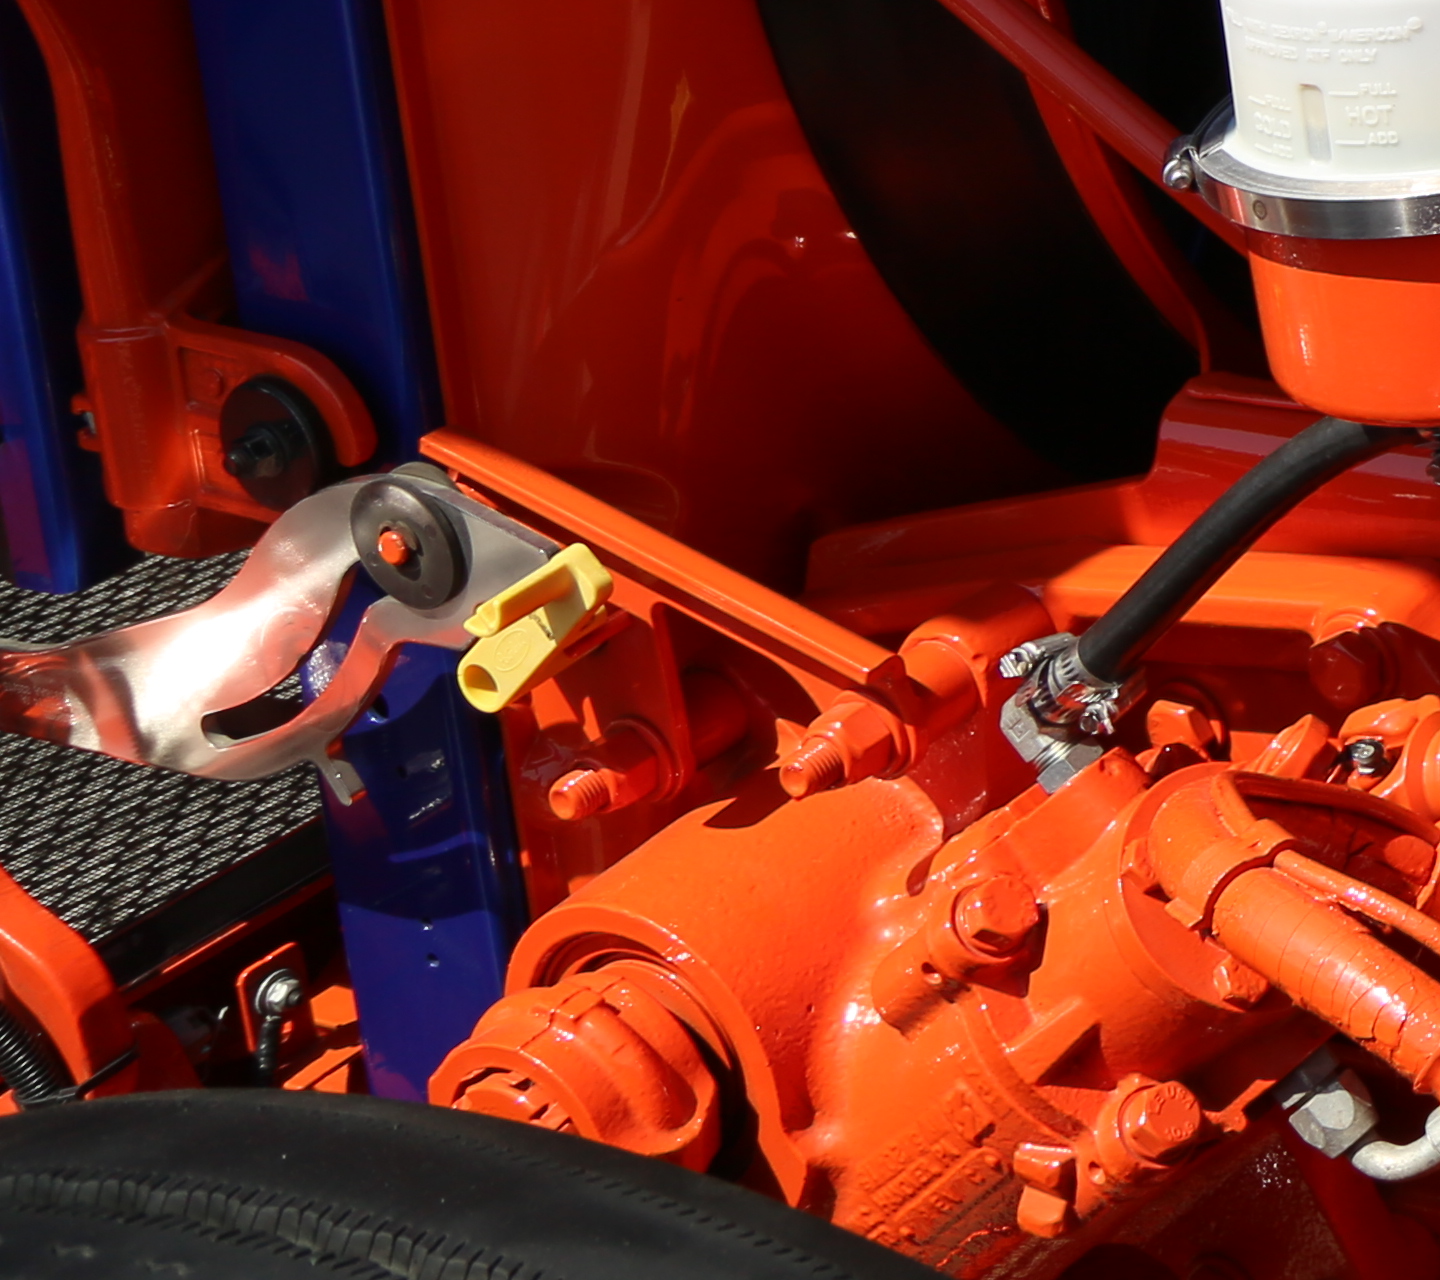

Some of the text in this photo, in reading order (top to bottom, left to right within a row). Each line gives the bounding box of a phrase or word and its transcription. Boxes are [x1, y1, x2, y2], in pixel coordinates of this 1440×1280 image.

[1305, 47, 1331, 61] ATF
[1337, 46, 1377, 64] ONLY
[1359, 82, 1397, 96] FULL
[1253, 104, 1393, 139] COLD HOT
[1367, 130, 1398, 145] ADD
